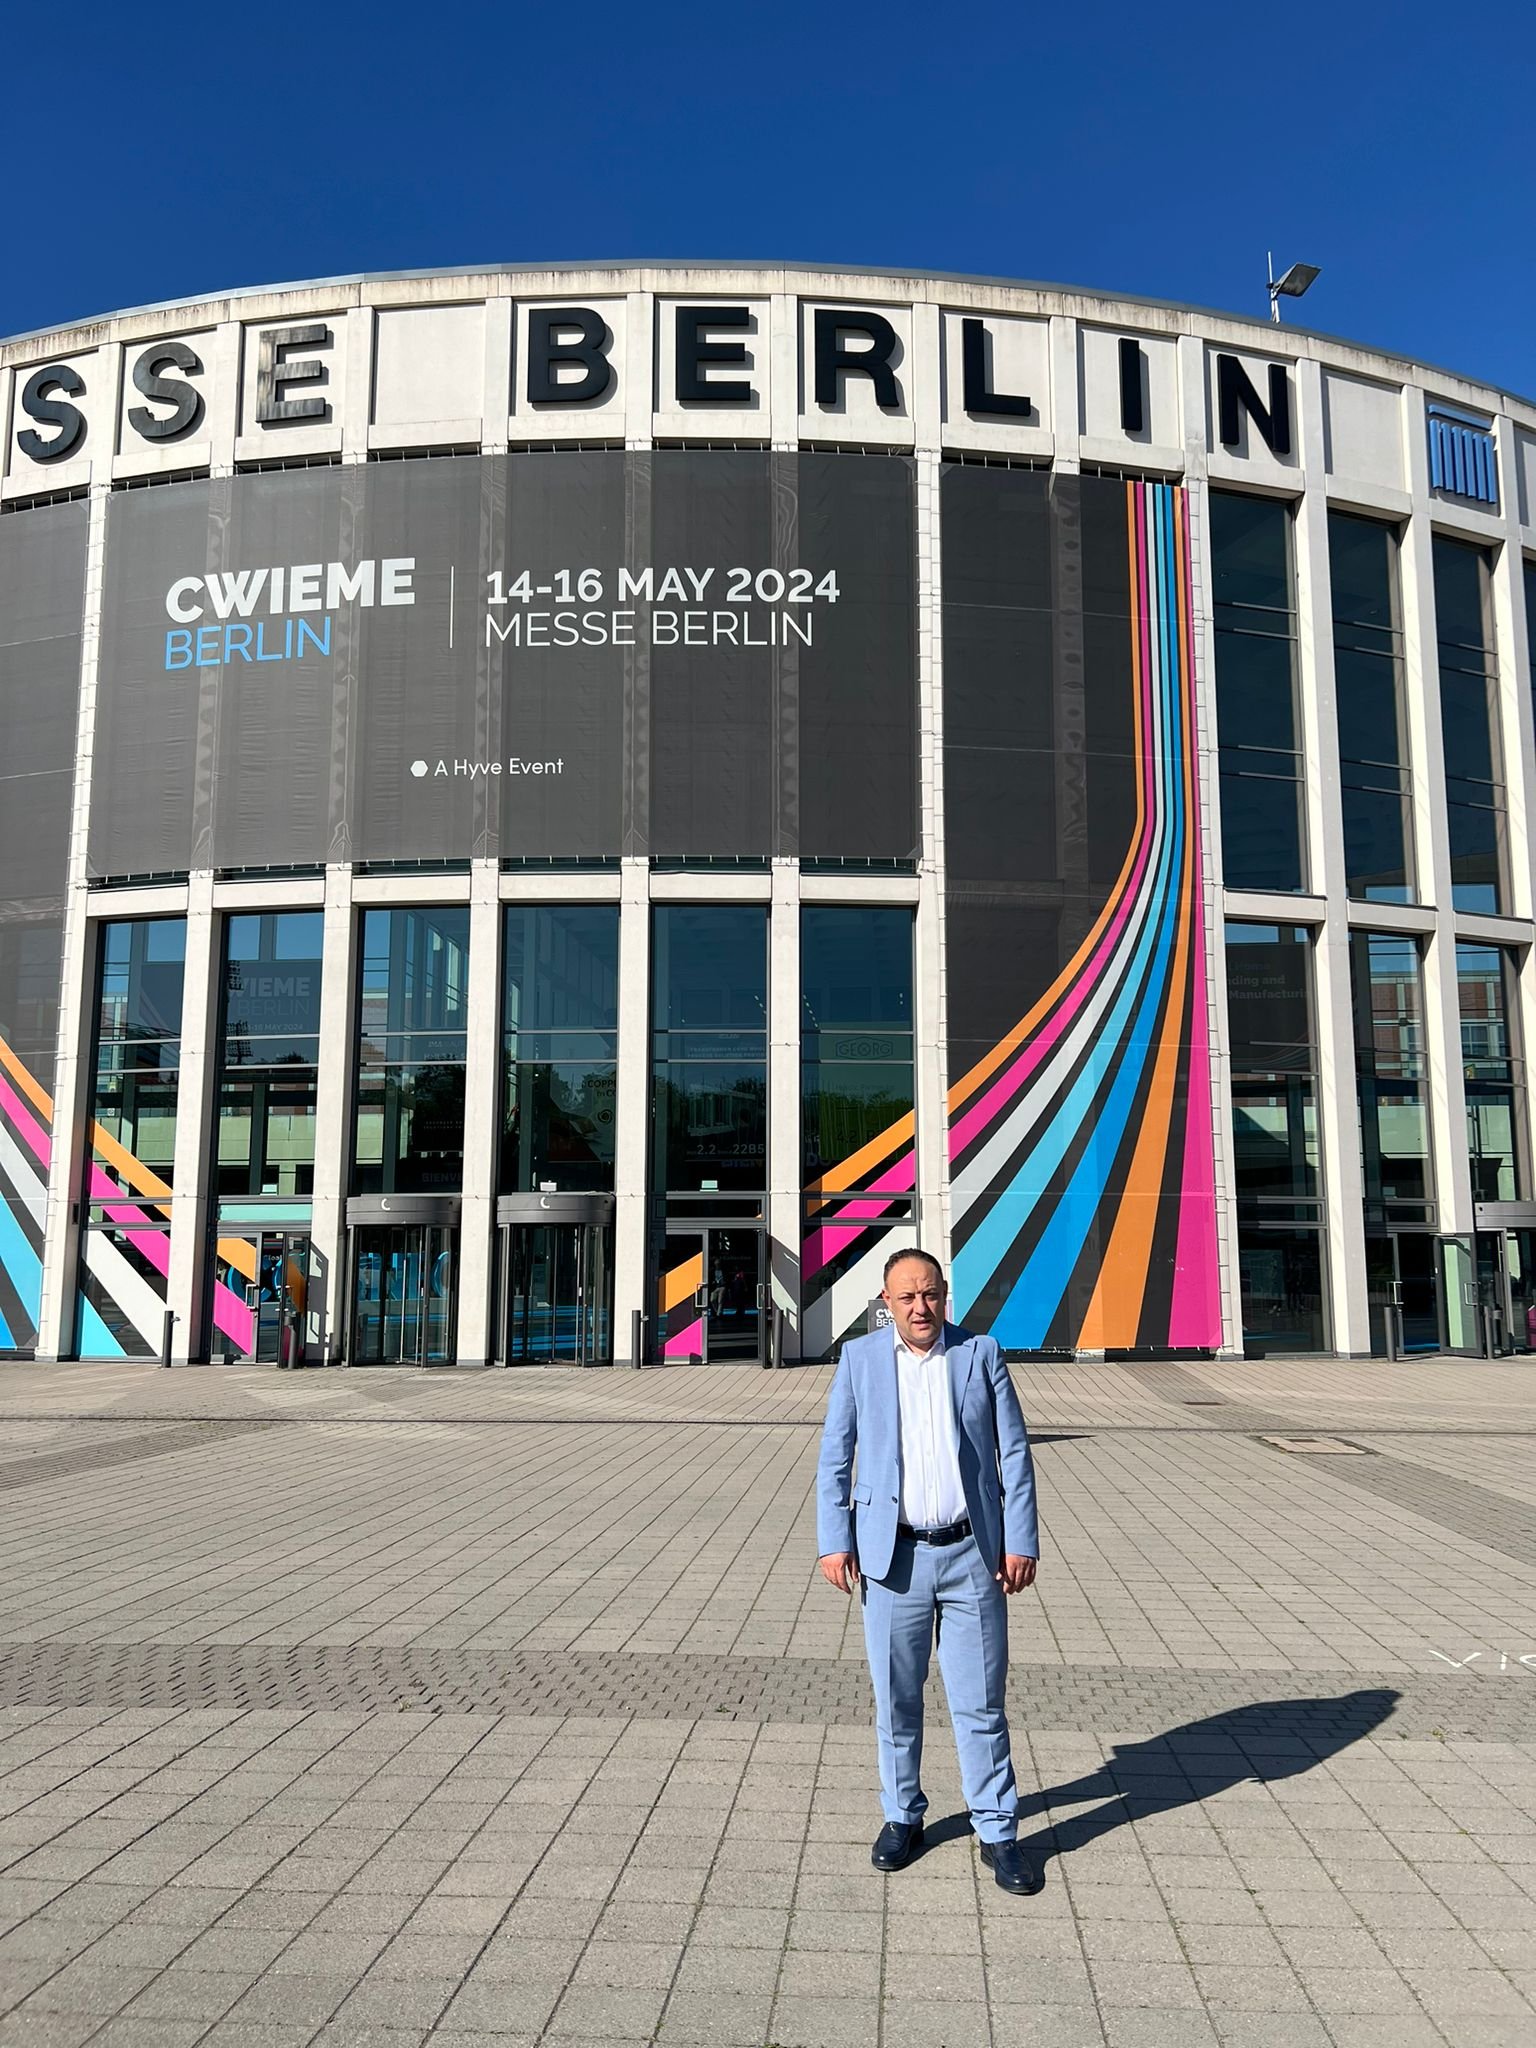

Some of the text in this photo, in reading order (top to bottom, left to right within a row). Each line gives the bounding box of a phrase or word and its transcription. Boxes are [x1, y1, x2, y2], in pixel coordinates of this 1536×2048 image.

[526, 306, 1291, 454] BERLIN
[165, 557, 416, 624] CWIEME
[486, 567, 840, 605] 14-16 MAY 2024
[165, 616, 331, 671] BERLIN
[485, 610, 813, 648] MESSE BERLIN
[433, 757, 565, 781] A Hyve Event
[238, 999, 310, 1016] BERLIN
[696, 1144, 717, 1155] 2.2
